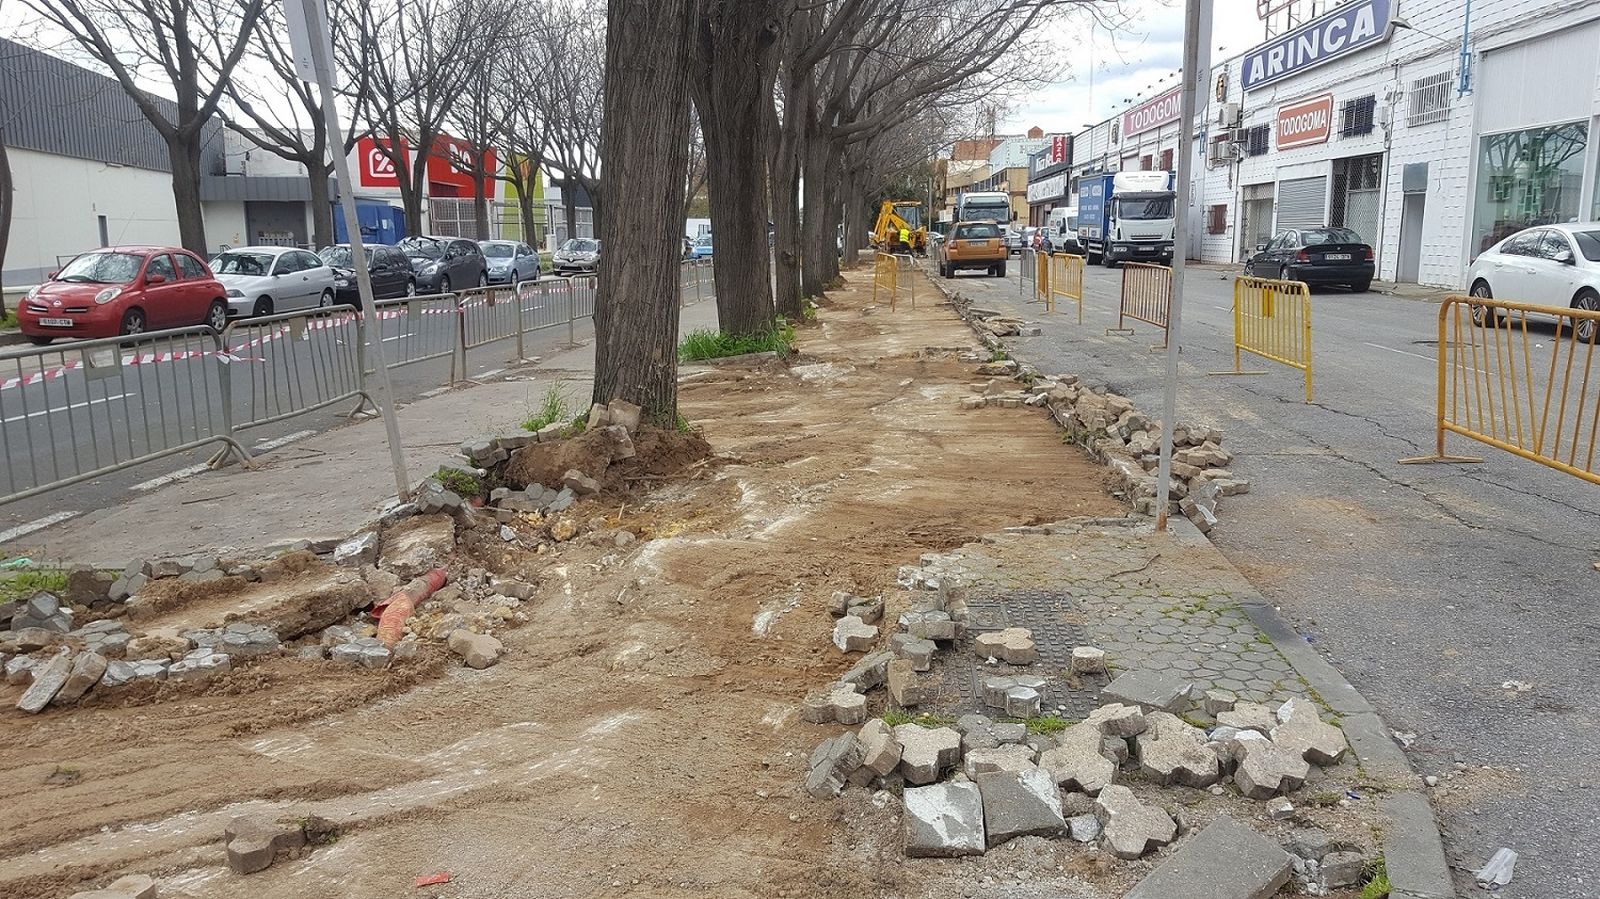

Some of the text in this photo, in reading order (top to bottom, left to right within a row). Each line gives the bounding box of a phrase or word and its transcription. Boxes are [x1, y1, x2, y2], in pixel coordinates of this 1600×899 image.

[1249, 4, 1376, 84] ARINCA
[1130, 92, 1182, 131] TODOGOM
[1280, 109, 1327, 137] TODOGOMA
[1055, 136, 1063, 164] BAZAR
